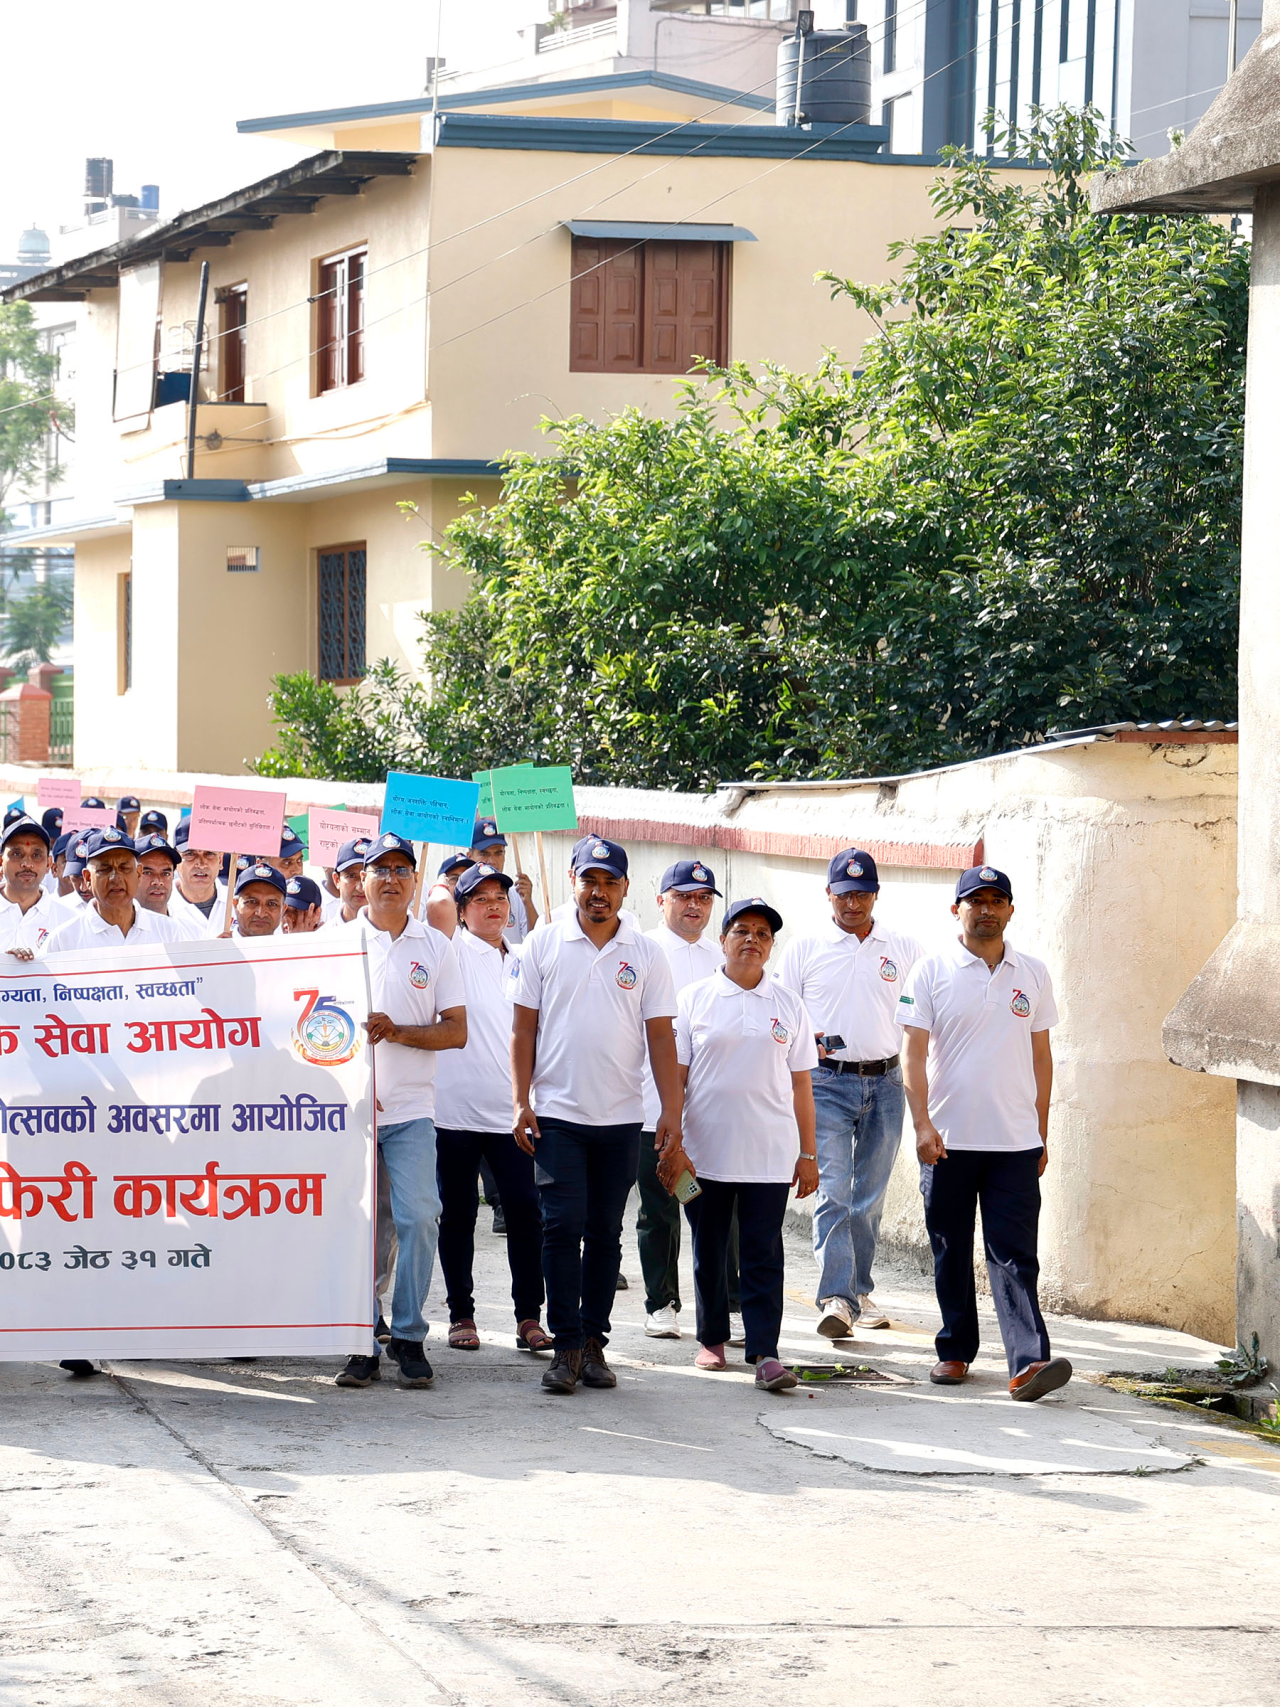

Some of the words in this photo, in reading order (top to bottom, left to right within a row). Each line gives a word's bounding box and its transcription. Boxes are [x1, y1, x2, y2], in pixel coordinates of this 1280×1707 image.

[319, 820, 349, 832] योग्यताको
[351, 826, 373, 837] सम्मान,
[319, 838, 339, 850] राष्ट्रको
[53, 984, 128, 1001] निष्पक्षता,
[34, 1014, 111, 1057] सेवा
[126, 1008, 261, 1053] आयोग
[107, 1105, 221, 1134] अवसरमा
[232, 1094, 347, 1132] आयोजित
[114, 1161, 326, 1220] कार्यक्रम
[63, 1245, 112, 1269] जेठ
[122, 1251, 156, 1270] ३१
[167, 1244, 212, 1268] गते
